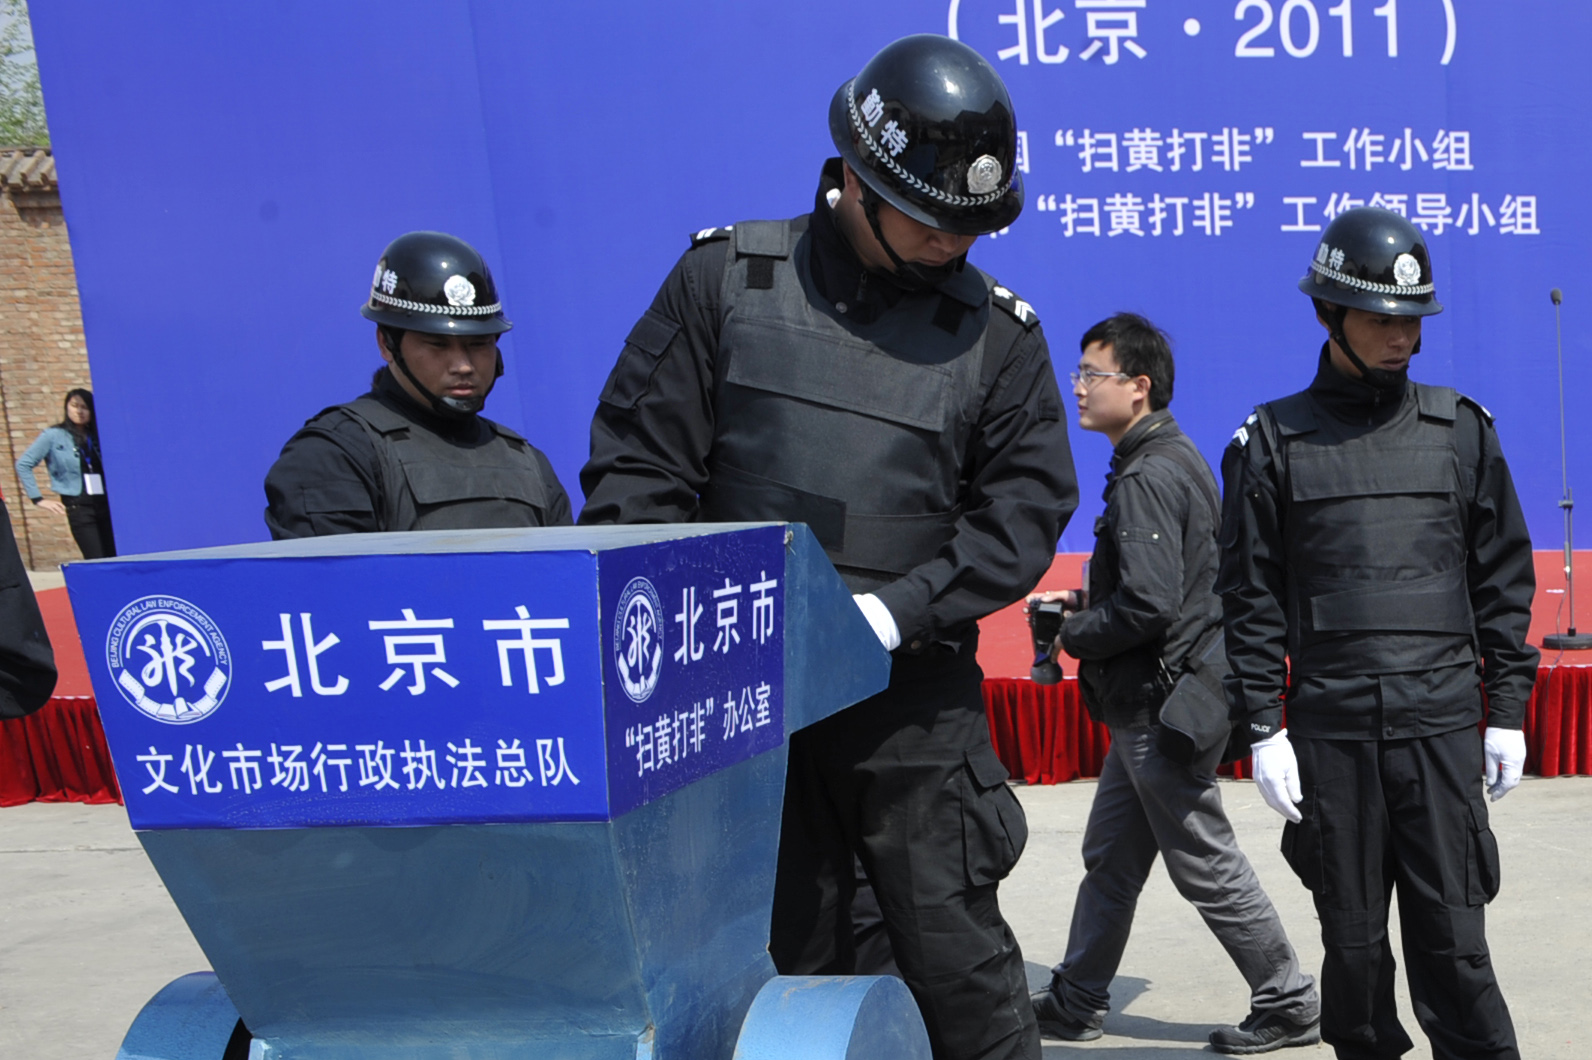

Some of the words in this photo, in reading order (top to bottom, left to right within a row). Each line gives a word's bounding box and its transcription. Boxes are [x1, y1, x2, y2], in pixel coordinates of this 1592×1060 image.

[261, 604, 570, 698] 北京市
[673, 570, 778, 665] 北京市
[136, 736, 580, 795] 文化市场行政执法总队
